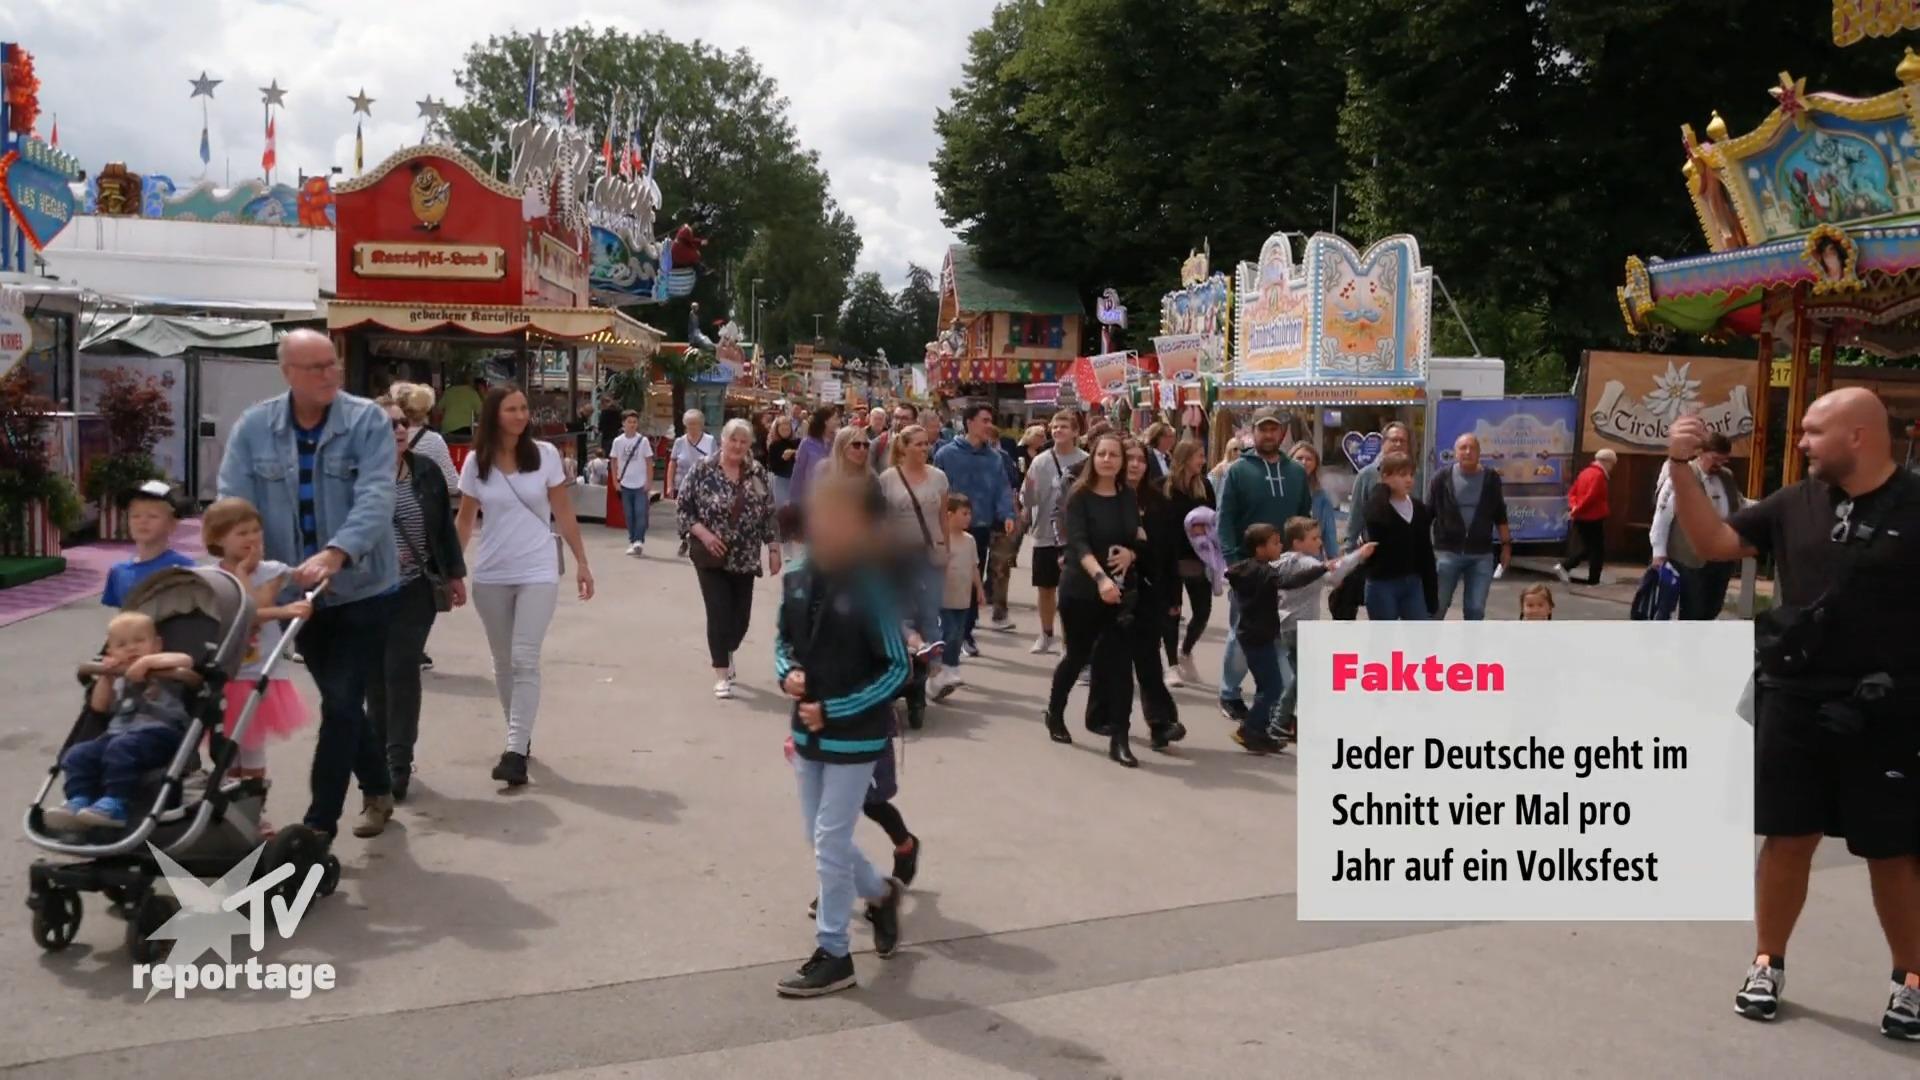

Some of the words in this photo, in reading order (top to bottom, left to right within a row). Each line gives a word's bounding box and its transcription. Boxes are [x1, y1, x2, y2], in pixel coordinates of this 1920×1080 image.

[18, 184, 36, 210] LAS
[40, 193, 69, 222] VEGAS
[410, 310, 467, 322] gebackene
[470, 311, 531, 325] Kartoffeln
